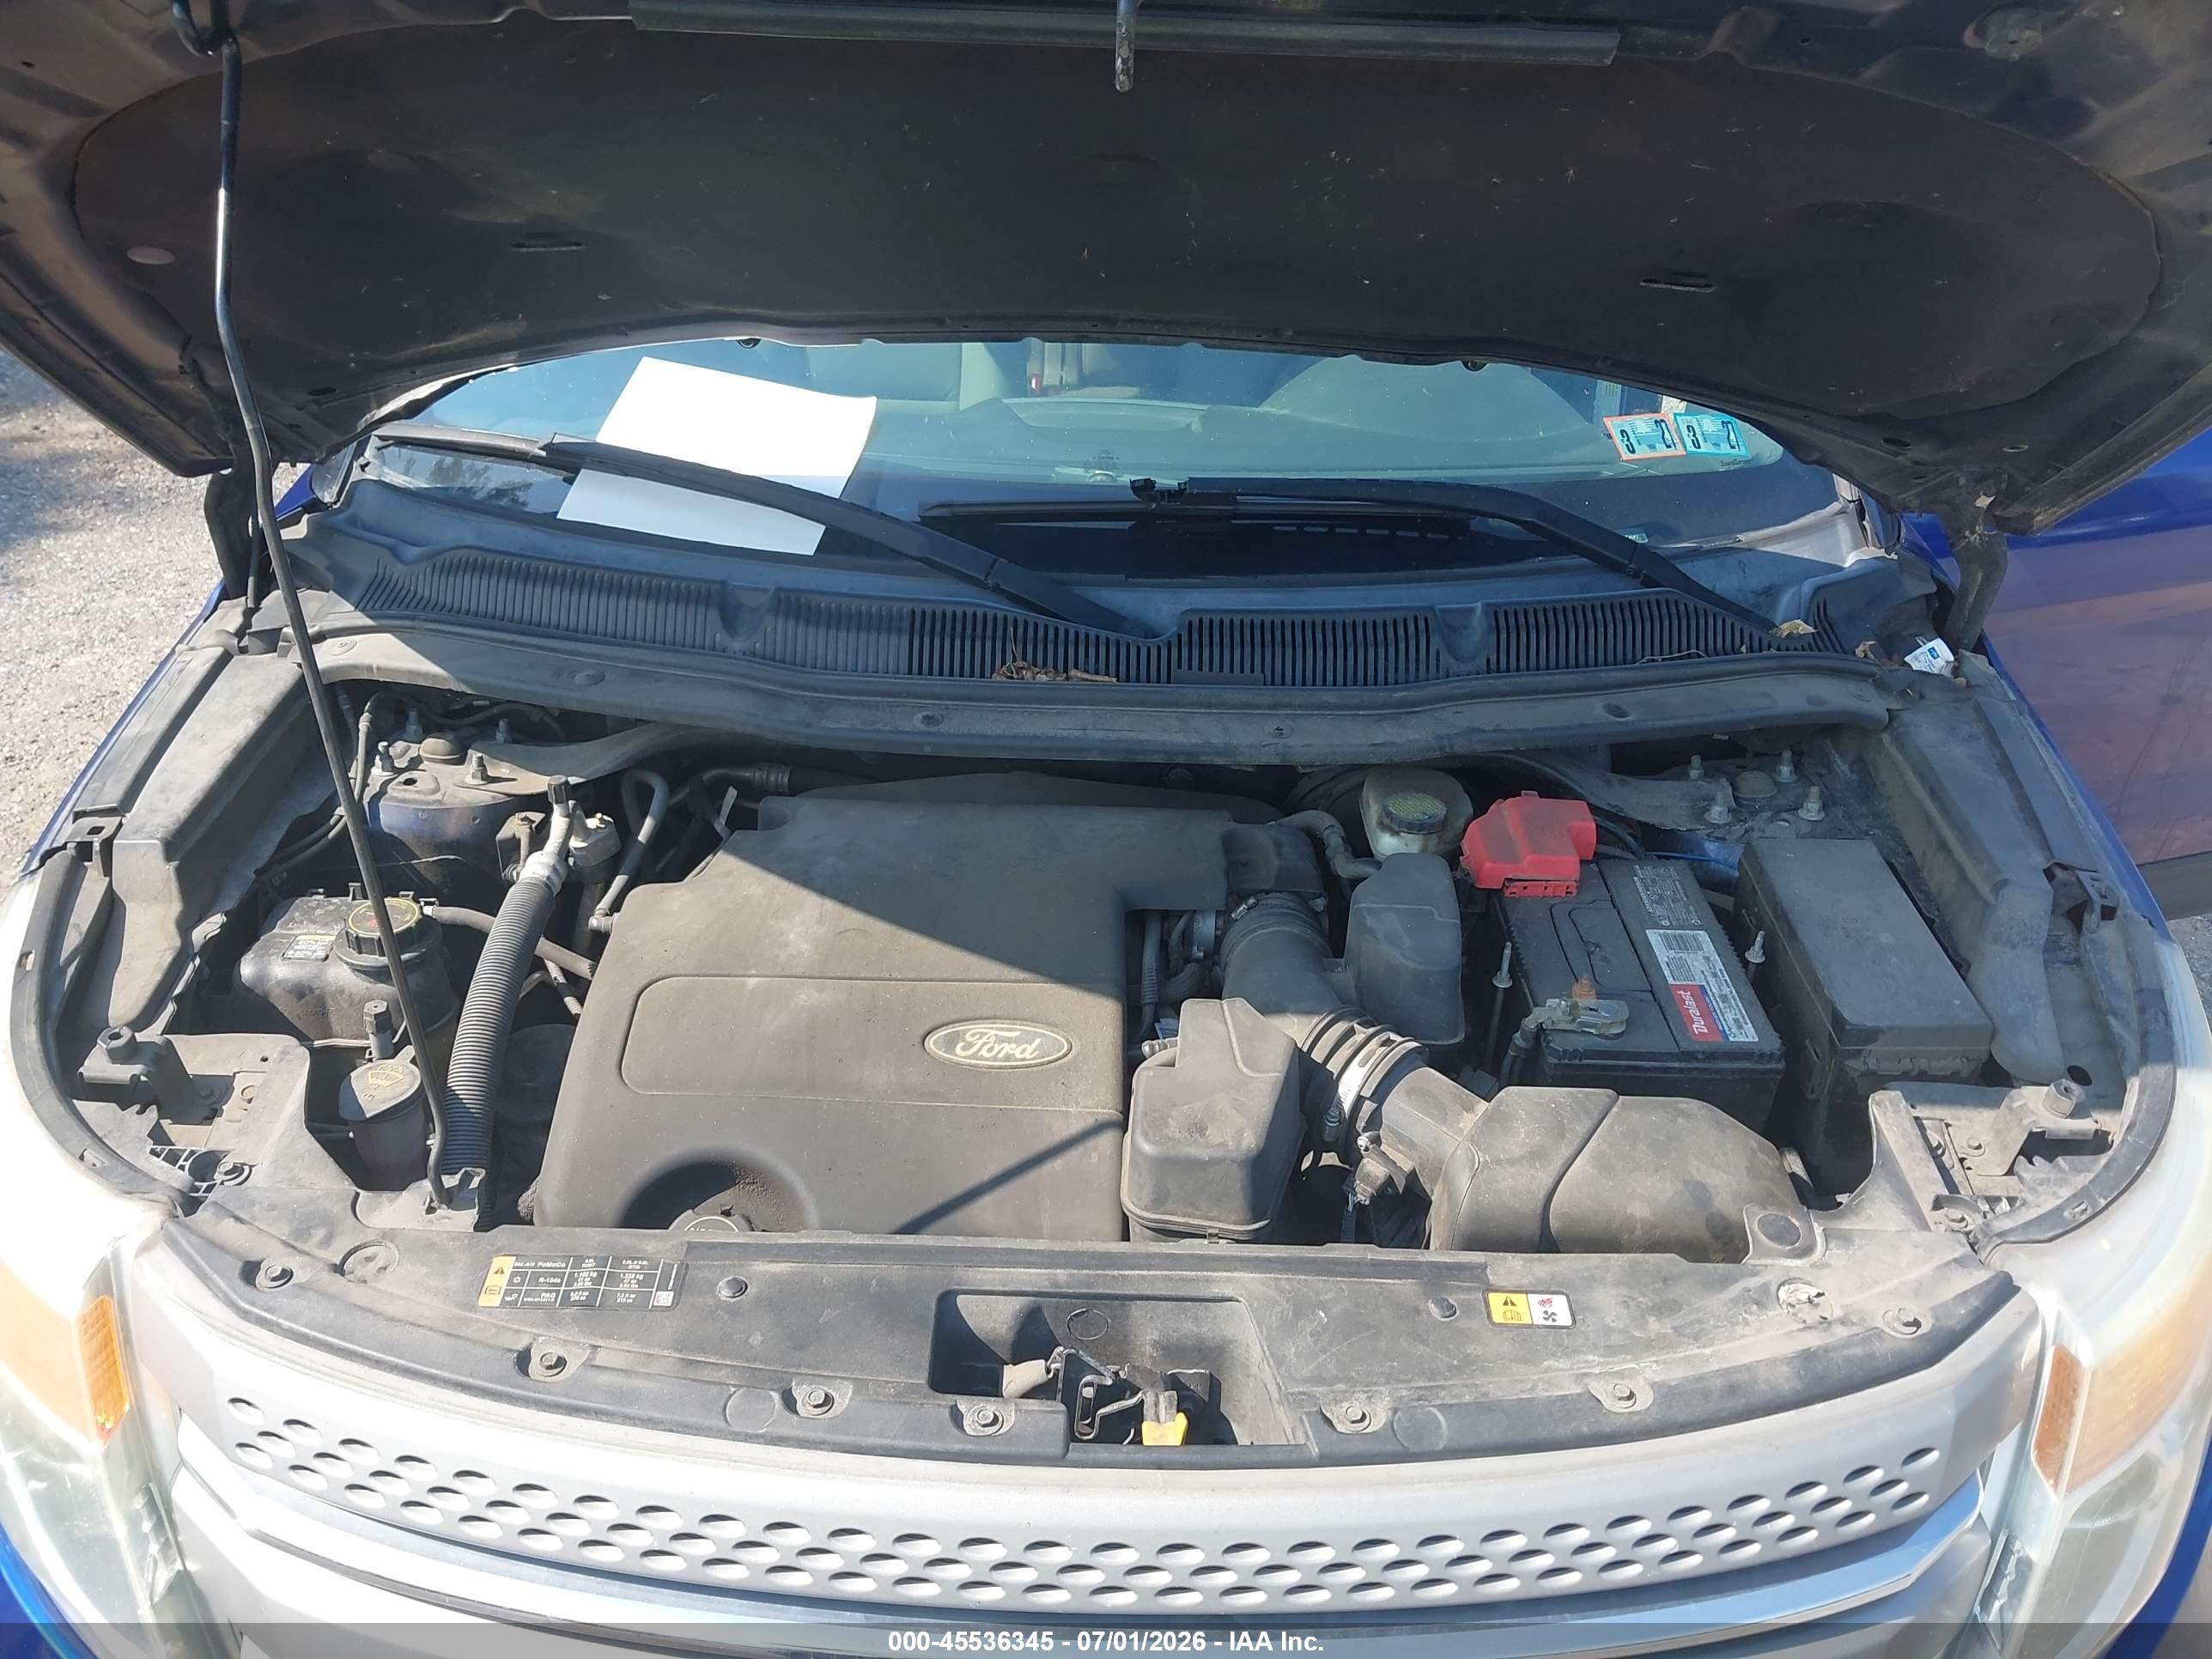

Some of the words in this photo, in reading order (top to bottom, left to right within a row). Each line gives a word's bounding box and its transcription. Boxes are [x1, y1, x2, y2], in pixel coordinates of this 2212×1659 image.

[1620, 429, 1636, 454] 3
[1686, 425, 1701, 449] 3
[1676, 990, 1709, 1035] Duralast
[955, 1029, 1042, 1060] Ford
